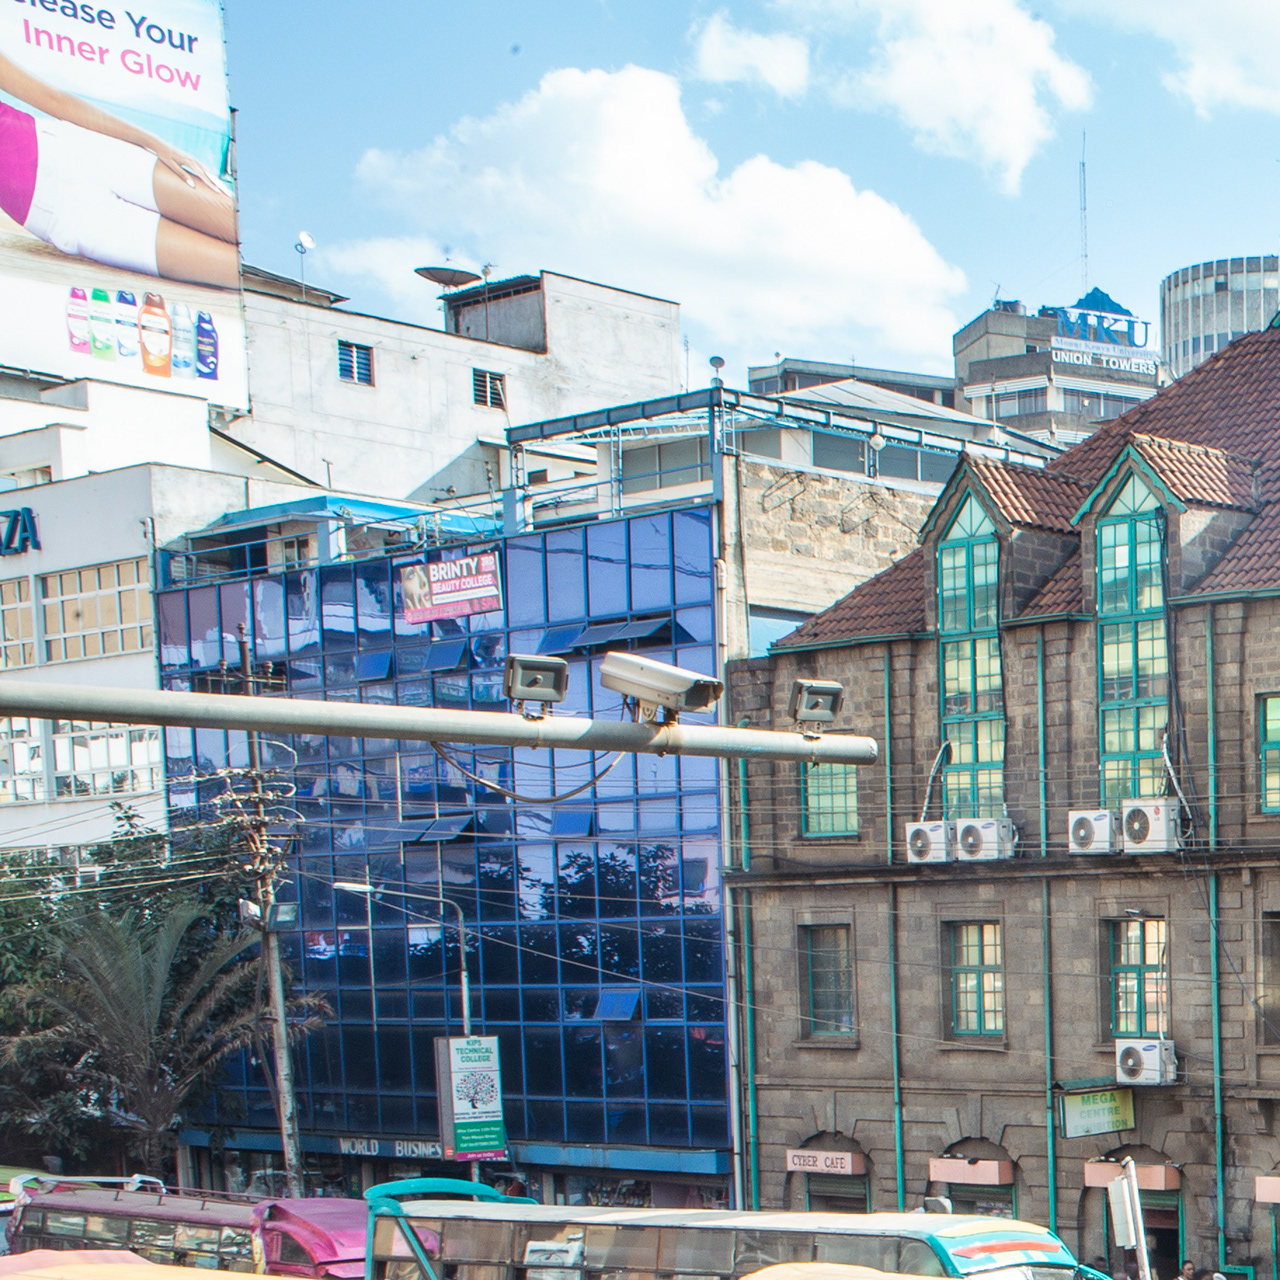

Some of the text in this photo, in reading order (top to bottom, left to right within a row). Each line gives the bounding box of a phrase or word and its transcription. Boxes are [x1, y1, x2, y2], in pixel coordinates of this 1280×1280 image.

[125, 10, 198, 53] Your
[23, 18, 201, 91] Inner Glow
[1057, 308, 1152, 348] MKU
[1052, 350, 1157, 375] UNION TOWERS
[430, 557, 478, 582] BRINTY
[432, 573, 493, 594] BEAUTY COLLEGE
[455, 1047, 493, 1055] TECHNICAL
[460, 1055, 491, 1063] COLLEGE
[1081, 1093, 1116, 1106] MEGA
[1080, 1106, 1120, 1119] CENTRE
[339, 1137, 442, 1158] WORLD BUSINES
[791, 1154, 846, 1169] CYBER CAFE
